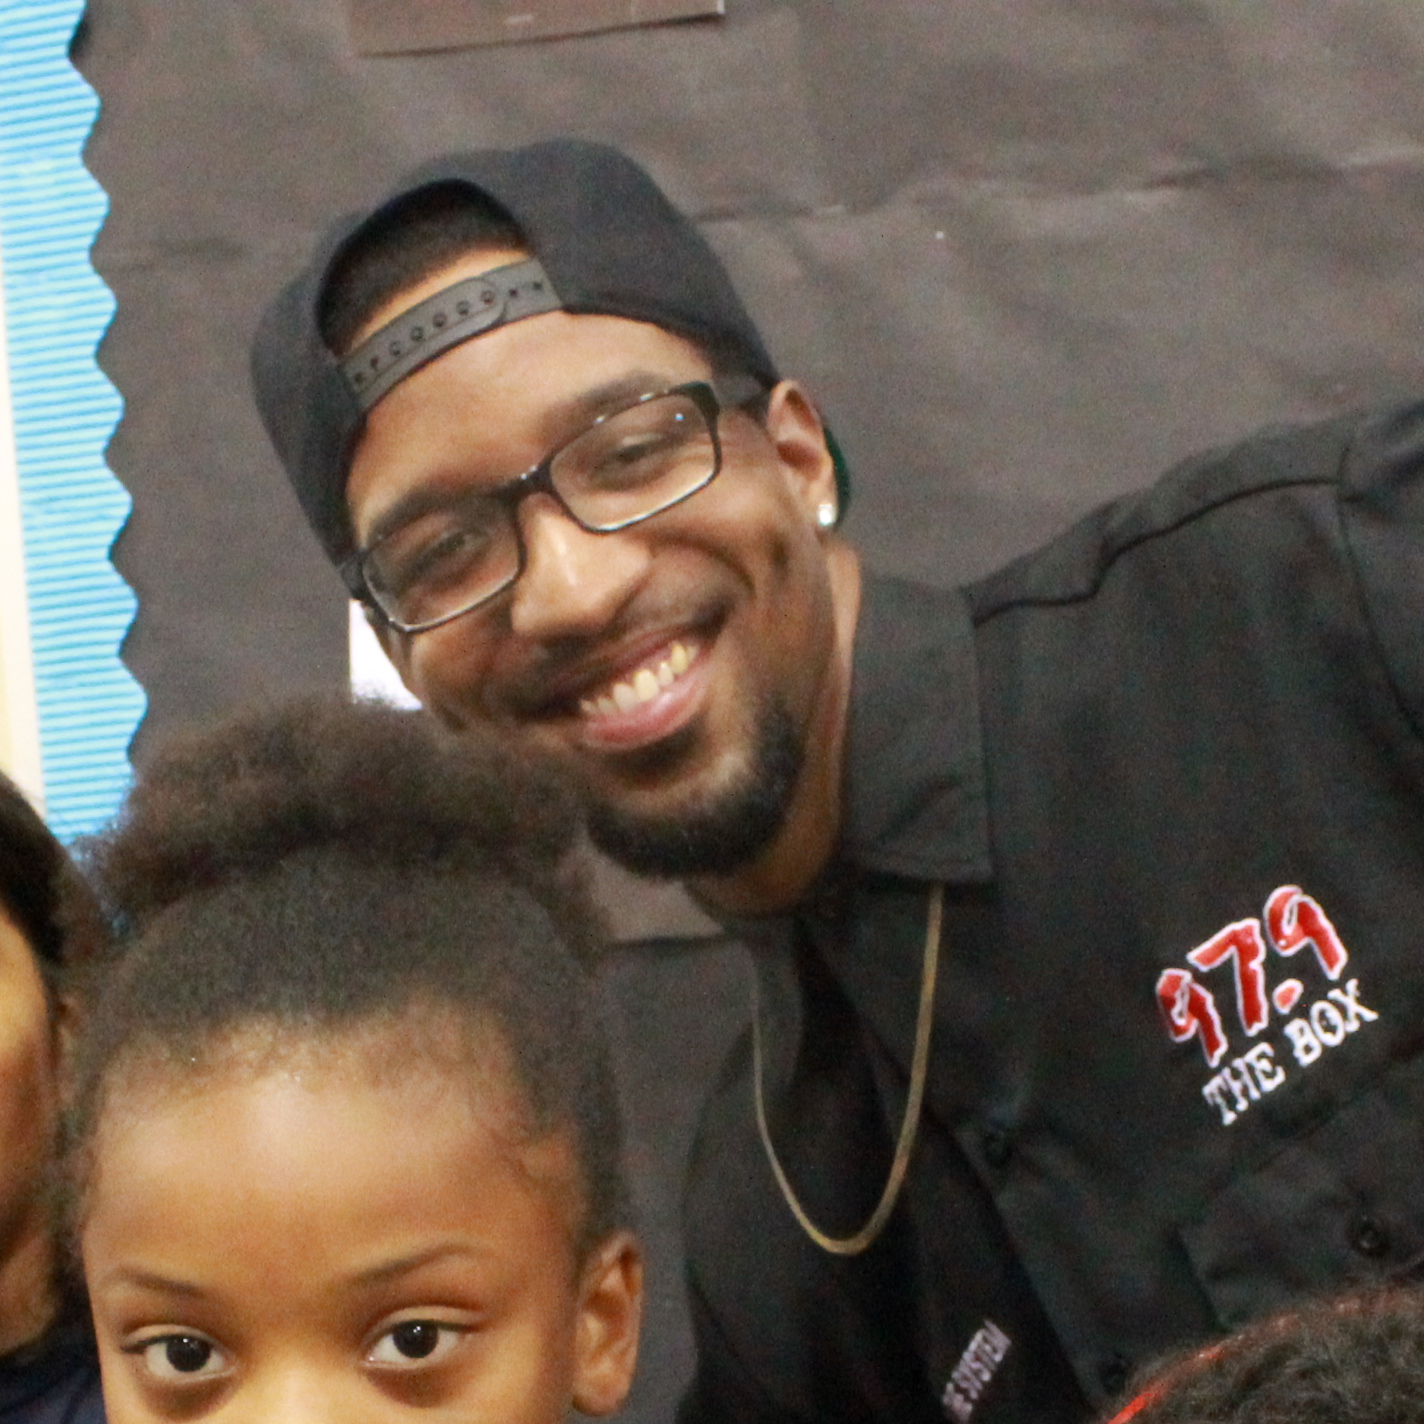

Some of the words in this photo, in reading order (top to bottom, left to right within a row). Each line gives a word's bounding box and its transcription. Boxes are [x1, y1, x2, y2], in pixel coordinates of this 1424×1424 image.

[1155, 884, 1349, 1068] 97.9
[1201, 1041, 1286, 1126] THE
[1283, 977, 1379, 1067] BOX
